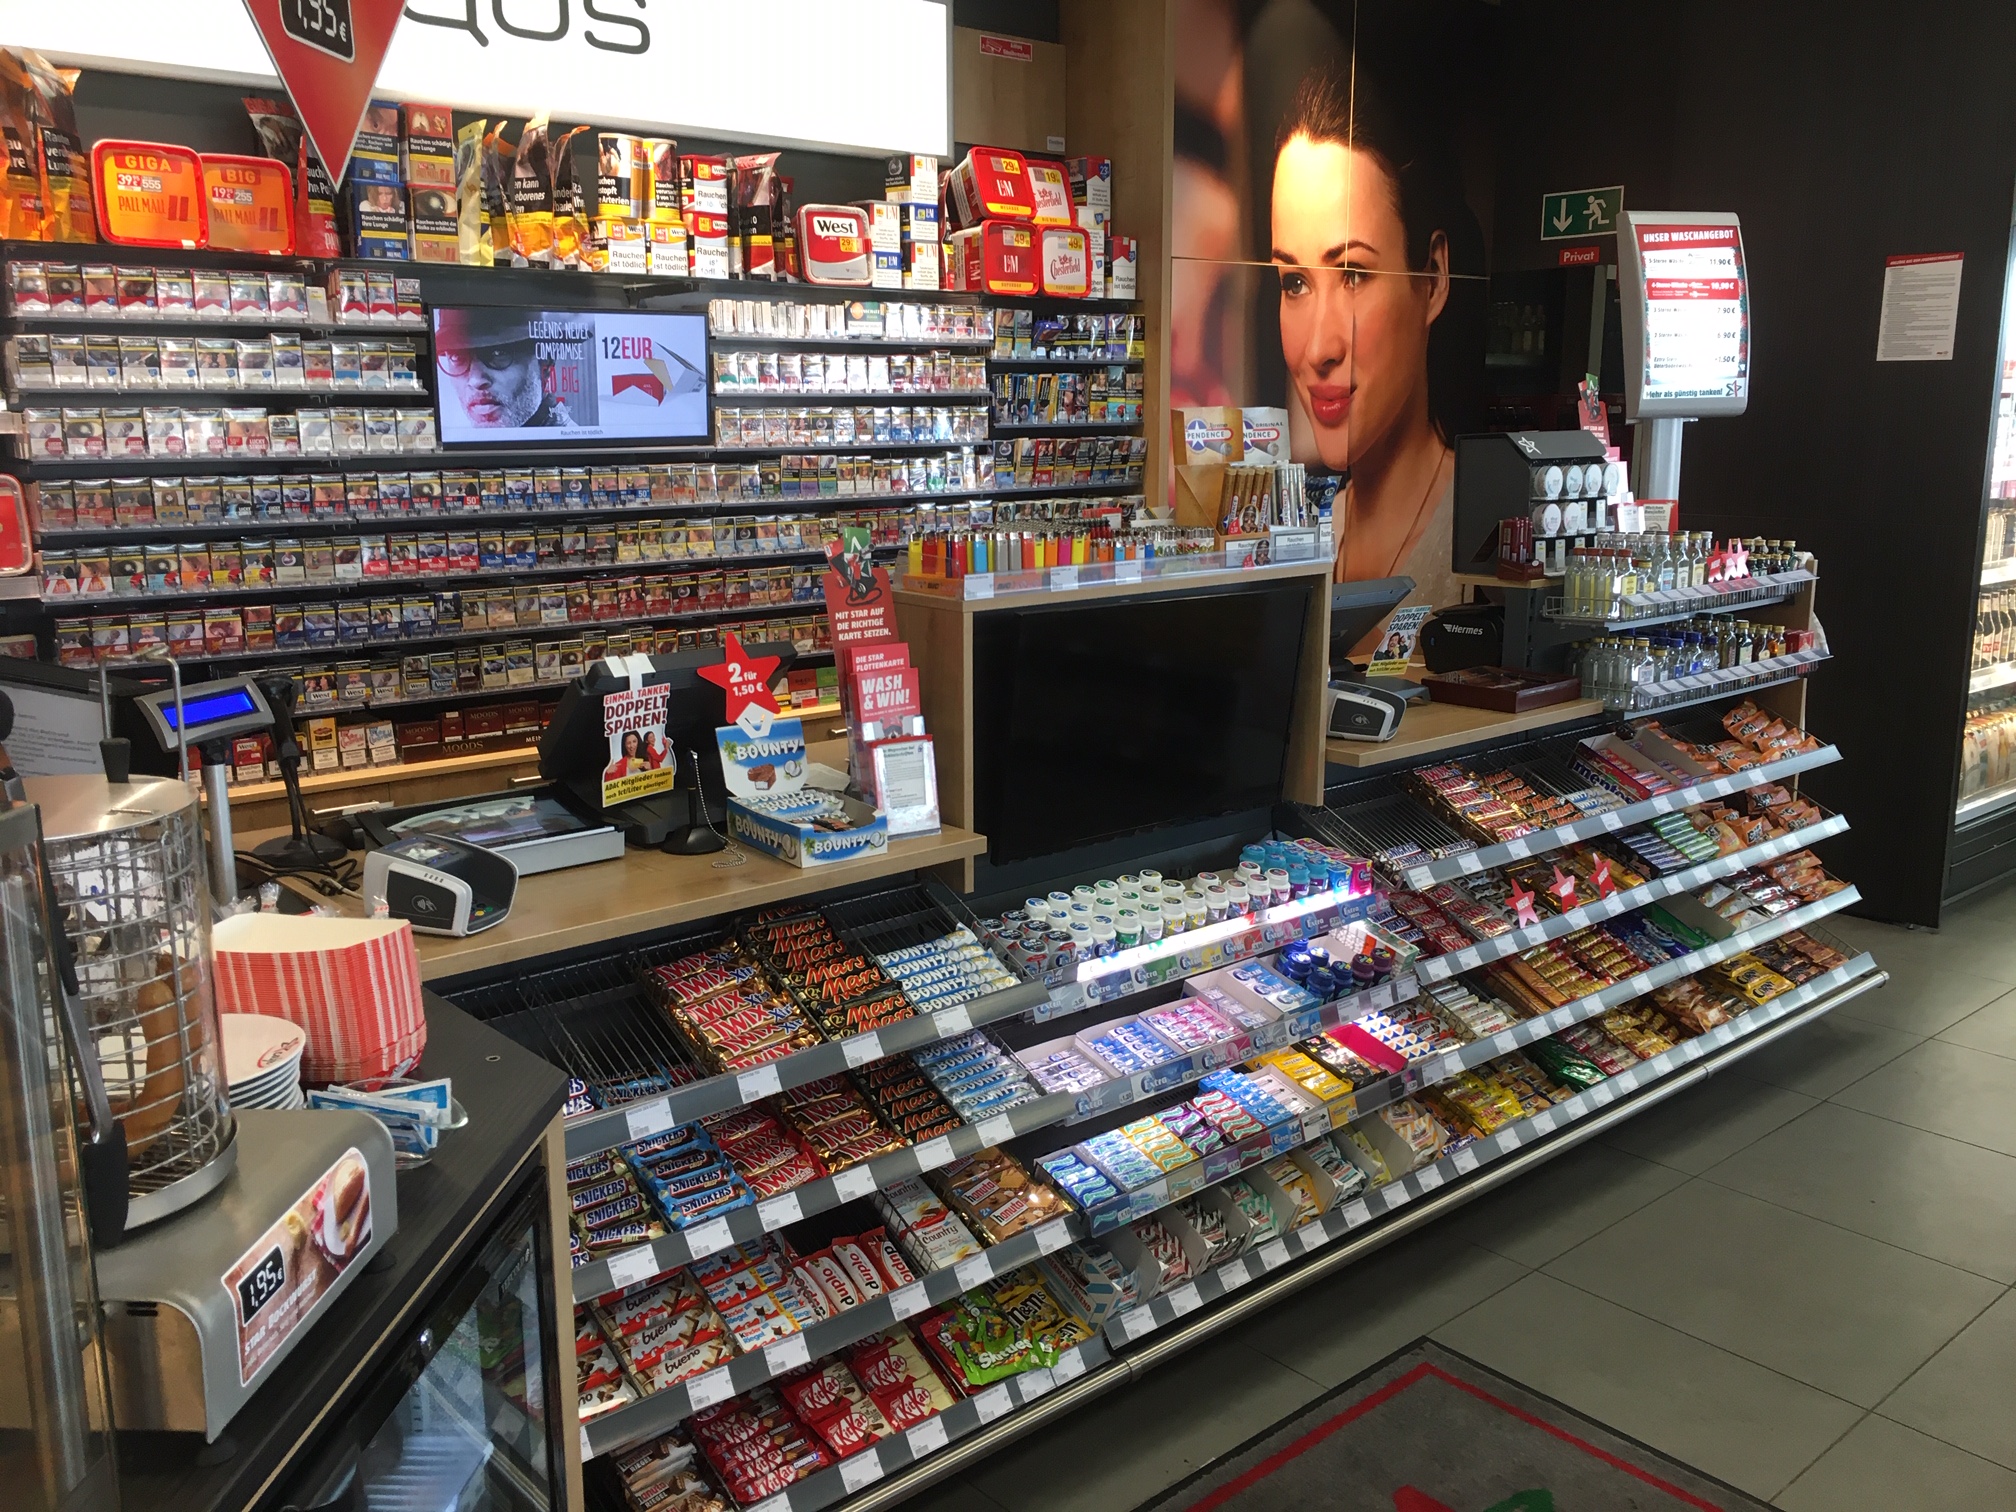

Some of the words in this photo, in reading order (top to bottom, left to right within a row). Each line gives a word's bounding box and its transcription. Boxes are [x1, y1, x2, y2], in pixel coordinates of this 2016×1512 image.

[125, 155, 172, 171] GIGA
[226, 170, 255, 183] BIG
[118, 195, 140, 213] PALL
[142, 197, 166, 214] MALL
[602, 197, 630, 206] Arterien
[698, 191, 727, 200] Rauchen
[214, 208, 233, 224] PALL
[234, 210, 258, 225] MALL
[816, 220, 854, 234] West
[1644, 231, 1670, 243] UNSER
[1671, 229, 1734, 242] WASCHANGEBOT
[612, 251, 645, 260] Rauchen
[655, 253, 687, 262] Rauchen
[697, 248, 728, 257] Rauchen
[1563, 251, 1594, 262] Privat
[1050, 258, 1080, 280] Chesterfield
[528, 320, 564, 339] LEGENDS
[565, 322, 590, 340] NEVER
[602, 336, 653, 360] 12EUR
[561, 367, 579, 393] BIG
[1674, 389, 1697, 399] günstig
[1187, 431, 1225, 439] PENDENCE
[835, 610, 848, 620] MIT
[850, 608, 868, 619] STAR
[869, 607, 885, 617] AUF
[837, 621, 848, 630] DIE
[850, 618, 884, 629] RICHTIGE
[1391, 612, 1428, 623] DOPPELT
[838, 630, 862, 641] KARTE
[863, 628, 892, 639] SETZEN.
[1387, 622, 1420, 633] SPAREN!
[1452, 624, 1483, 635] Hermes
[855, 655, 867, 664] DIE
[868, 653, 884, 662] STAR
[856, 658, 904, 672] FLOTTENKARTE
[728, 662, 743, 683] 2
[744, 671, 758, 680] für
[862, 674, 902, 693] WASH
[346, 688, 364, 696] West
[605, 692, 634, 705] EINMAL
[637, 684, 670, 698] TANKEN
[733, 685, 755, 696] 1,50
[756, 682, 763, 692] €
[863, 694, 873, 708] &
[876, 689, 910, 707] WIN!
[470, 710, 499, 720] MOODS
[508, 706, 536, 714] MOODS
[606, 695, 669, 720] DOPPELT
[405, 726, 434, 735] MOODS
[605, 710, 667, 736] SPAREN!
[442, 740, 484, 754] MOODS
[736, 741, 801, 760] BOUNTY
[605, 781, 620, 792] ADAC
[621, 773, 654, 789] Mitglieder
[1573, 761, 1636, 805] mentos
[736, 815, 782, 848] BOUNTY
[814, 834, 871, 854] BOUNTY
[1387, 842, 1420, 858] SNICKERS
[786, 938, 845, 969] Mars
[877, 943, 936, 966] BOUNTY
[655, 952, 712, 982] TWIX
[806, 955, 866, 986] Mars
[902, 965, 958, 990] BOUNTY
[667, 966, 730, 1002] TWIX
[846, 993, 905, 1026] Mars
[920, 987, 978, 1015] BOUNTY
[701, 1005, 769, 1040] TWIX
[957, 1070, 1006, 1093] BOUNTY
[1141, 1074, 1168, 1094] Extra
[967, 1083, 1017, 1106] BOUNTY
[904, 1104, 949, 1134] Mars
[638, 1128, 686, 1153] SNICKERS
[807, 1114, 870, 1149] TWIX
[657, 1151, 705, 1174] SNICKERS
[671, 1169, 720, 1193] SNICKERS
[751, 1158, 804, 1196] TWIX
[573, 1179, 626, 1208] SNICKERS
[683, 1185, 733, 1213] SNICKERS
[964, 1178, 998, 1204] hanuta
[587, 1195, 638, 1226] SNICKERS
[992, 1198, 1025, 1226] hanuta
[922, 1224, 958, 1246] Country
[850, 1252, 879, 1291] duplo
[884, 1244, 914, 1284] duplo
[822, 1267, 856, 1306] duplo
[268, 1267, 318, 1329] BOCKWURST
[626, 1288, 660, 1312] bueno
[1071, 1285, 1092, 1313] FRIEND
[641, 1318, 678, 1346] bueno
[739, 1325, 761, 1340] kinder
[743, 1331, 765, 1345] Riegel
[664, 1348, 700, 1375] bueno
[871, 1355, 907, 1387] KitKat
[803, 1376, 840, 1410] KitKat
[896, 1388, 931, 1420] KitKat
[833, 1412, 868, 1446] KitKat
[793, 1453, 819, 1470] CHUNKY
